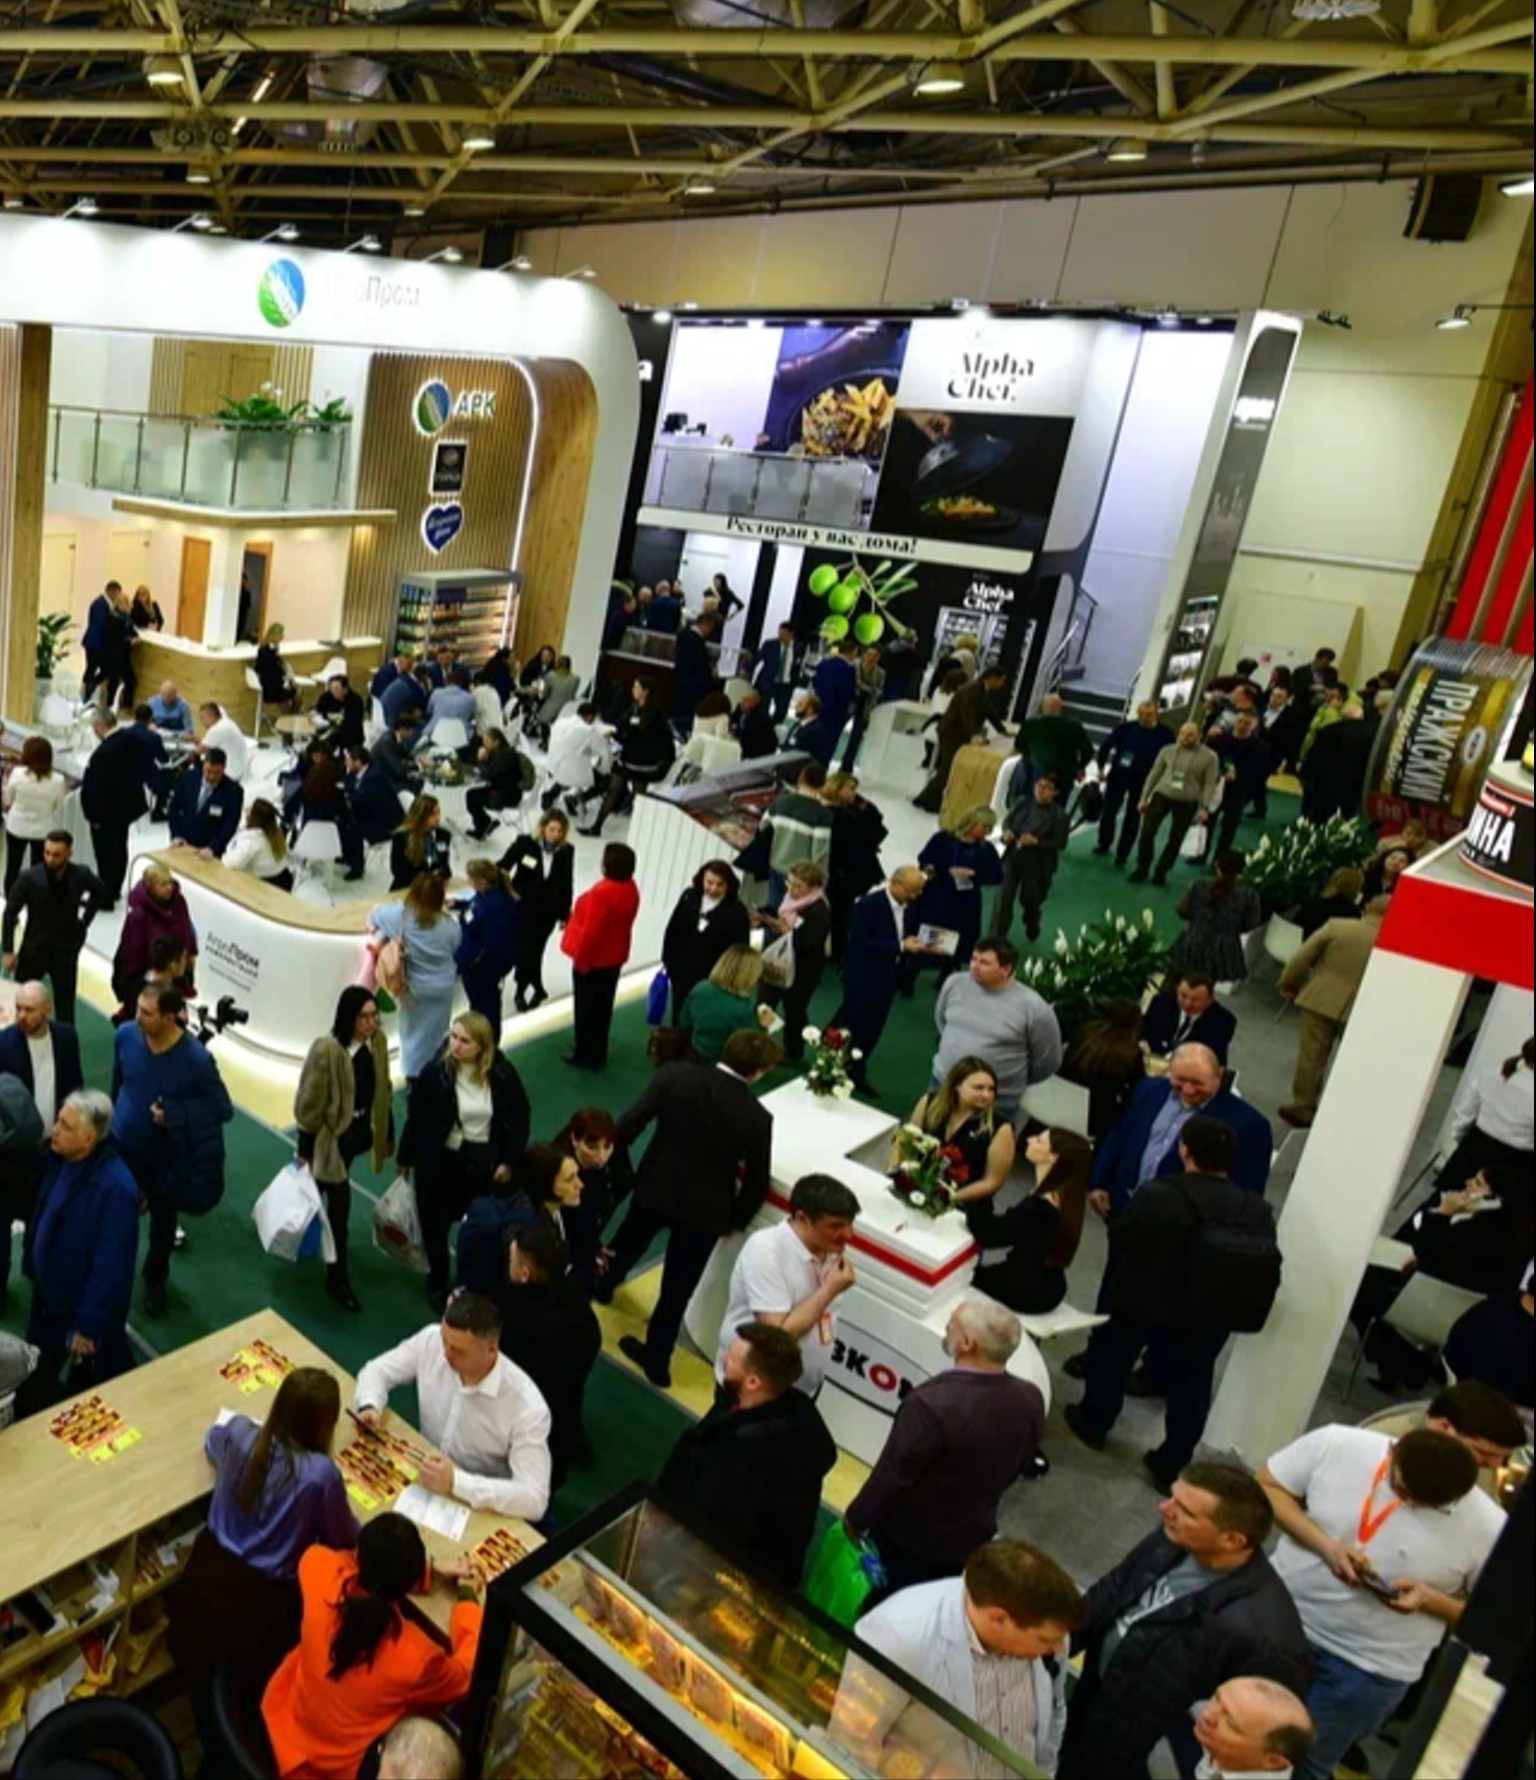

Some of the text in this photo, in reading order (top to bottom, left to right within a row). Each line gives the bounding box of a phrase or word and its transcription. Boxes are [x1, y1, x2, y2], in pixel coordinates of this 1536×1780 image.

[953, 352, 1034, 379] Alpha
[727, 516, 918, 554] Ресторан у вас дома!
[1399, 680, 1479, 803] ПРАЖСКИЙ
